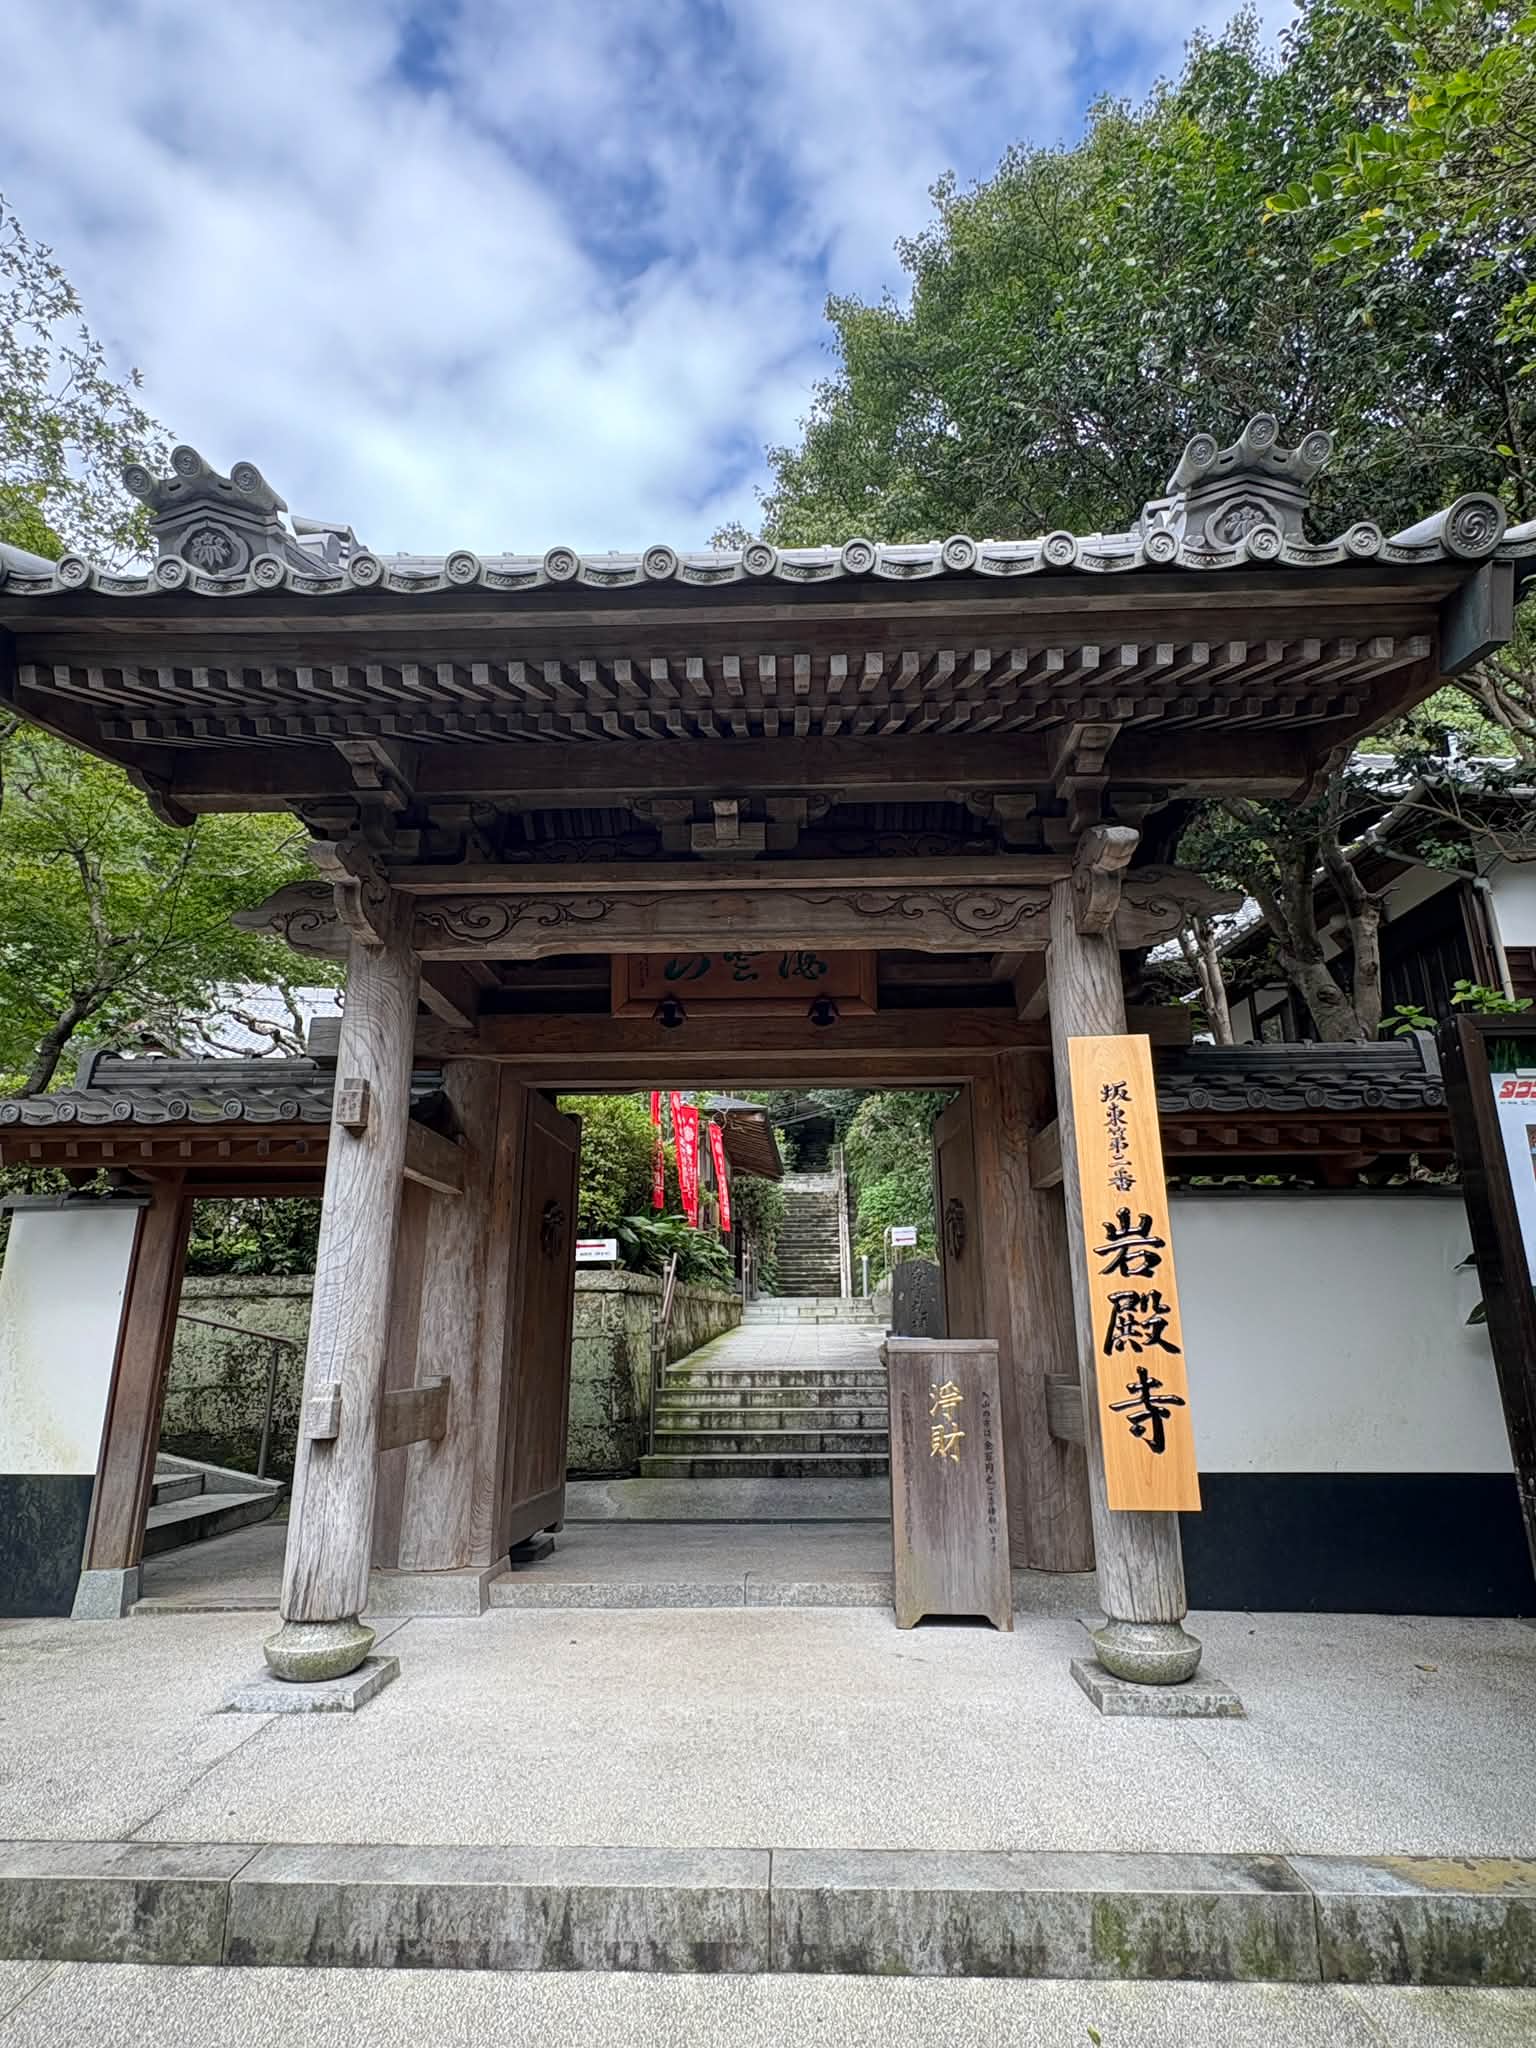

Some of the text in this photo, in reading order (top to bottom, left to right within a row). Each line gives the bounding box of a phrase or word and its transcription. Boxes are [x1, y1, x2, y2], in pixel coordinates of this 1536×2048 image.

[1100, 1080, 1137, 1193] 坂東第二番
[1094, 1206, 1186, 1454] 岩殿寺
